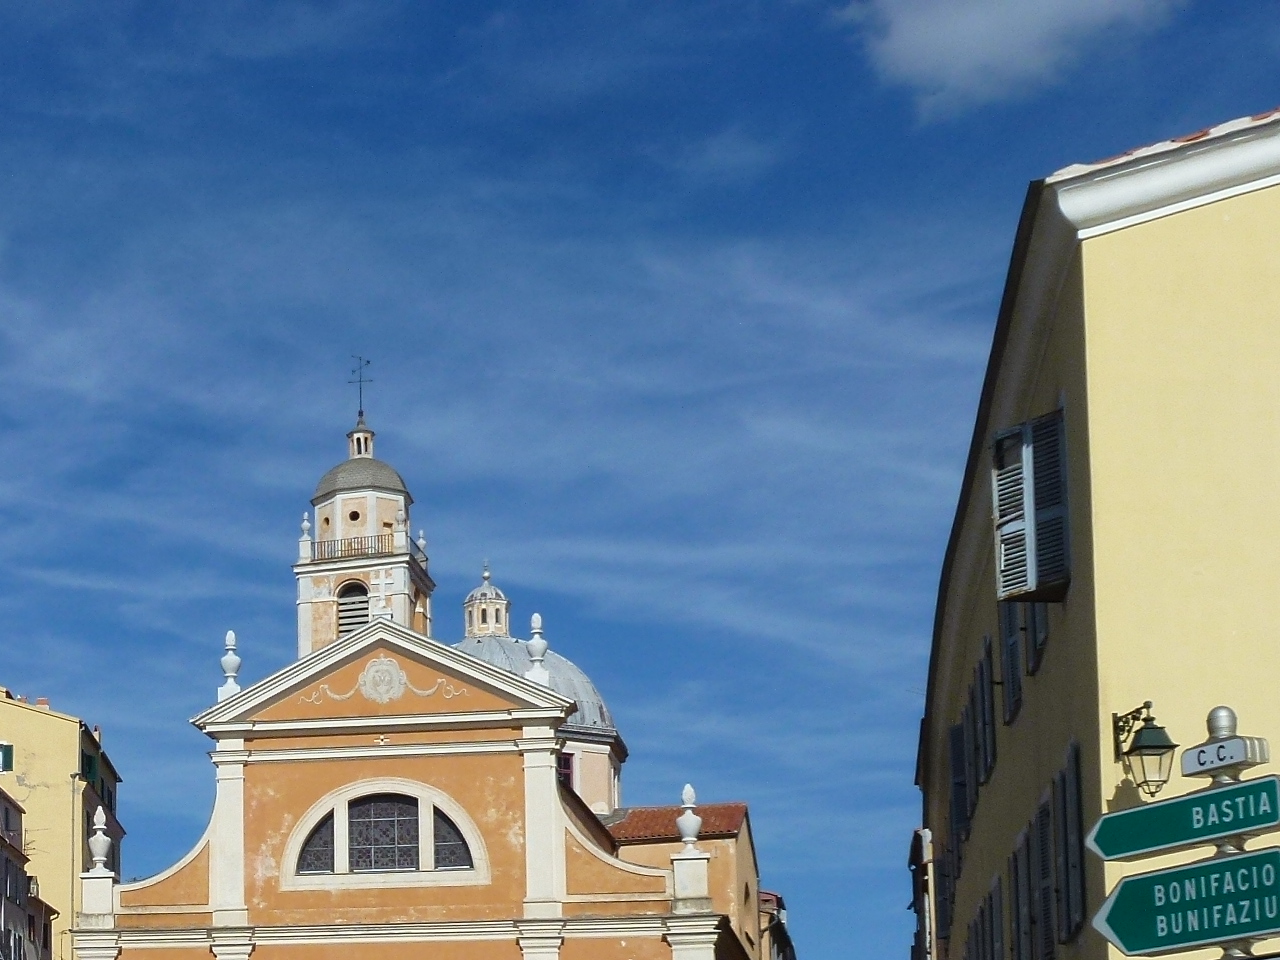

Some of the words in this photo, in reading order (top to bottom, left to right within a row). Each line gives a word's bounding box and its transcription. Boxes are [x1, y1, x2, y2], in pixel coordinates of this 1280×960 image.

[1197, 744, 1234, 766] C.C.
[1192, 791, 1272, 828] BASTIA
[1154, 863, 1275, 907] BONIFACIO
[1156, 895, 1277, 937] BUNIFAZIU
